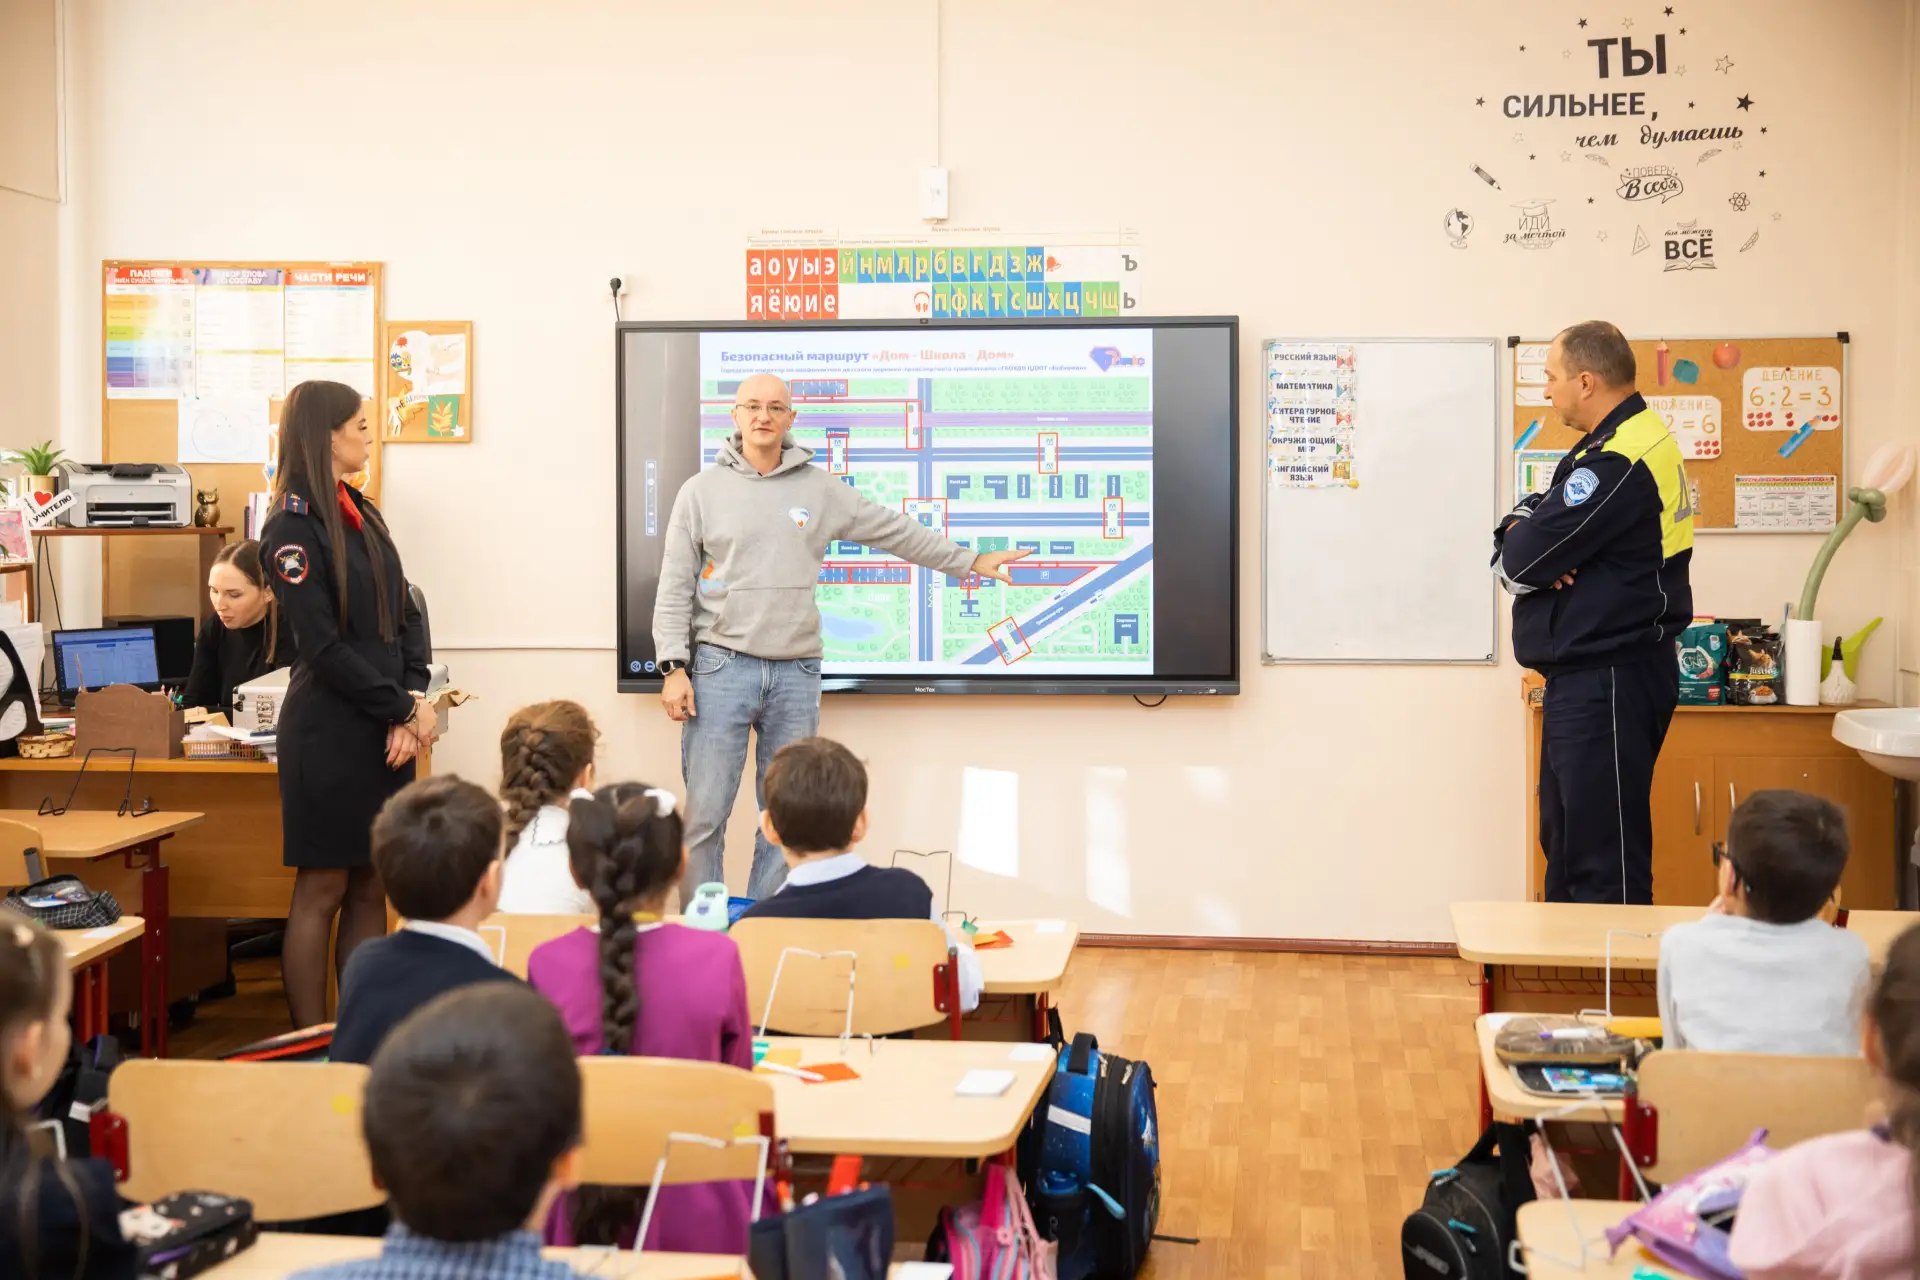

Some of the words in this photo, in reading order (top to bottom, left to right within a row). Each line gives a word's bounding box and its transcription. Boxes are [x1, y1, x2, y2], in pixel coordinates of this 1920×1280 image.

[1587, 34, 1667, 78] ТЫ
[1503, 92, 1659, 121] СИЛЬНЕЕ,
[1575, 131, 1619, 148] чем
[1640, 125, 1743, 149] думаешь
[1633, 165, 1673, 177] ПОВЕРЬ
[1625, 178, 1642, 199] В
[1644, 177, 1679, 195] себя
[1519, 216, 1550, 232] ИДИ
[1503, 233, 1517, 244] за
[1520, 228, 1566, 240] мечтой
[1664, 233, 1714, 260] ВСЁ
[294, 272, 332, 283] ЧАСТИ
[335, 272, 366, 283] РЕЧИ
[720, 350, 804, 363] Безопасный
[806, 351, 870, 363] маршрут
[920, 349, 967, 361] Школа
[1274, 352, 1312, 361] РУССКИЙ
[1313, 353, 1337, 361] ЯЗЫК
[1762, 370, 1822, 382] ДЕЛЕНИЕ
[1647, 398, 1713, 411] НОЖЕНИЕ
[33, 494, 72, 523] УЧИТЕЛЮ
